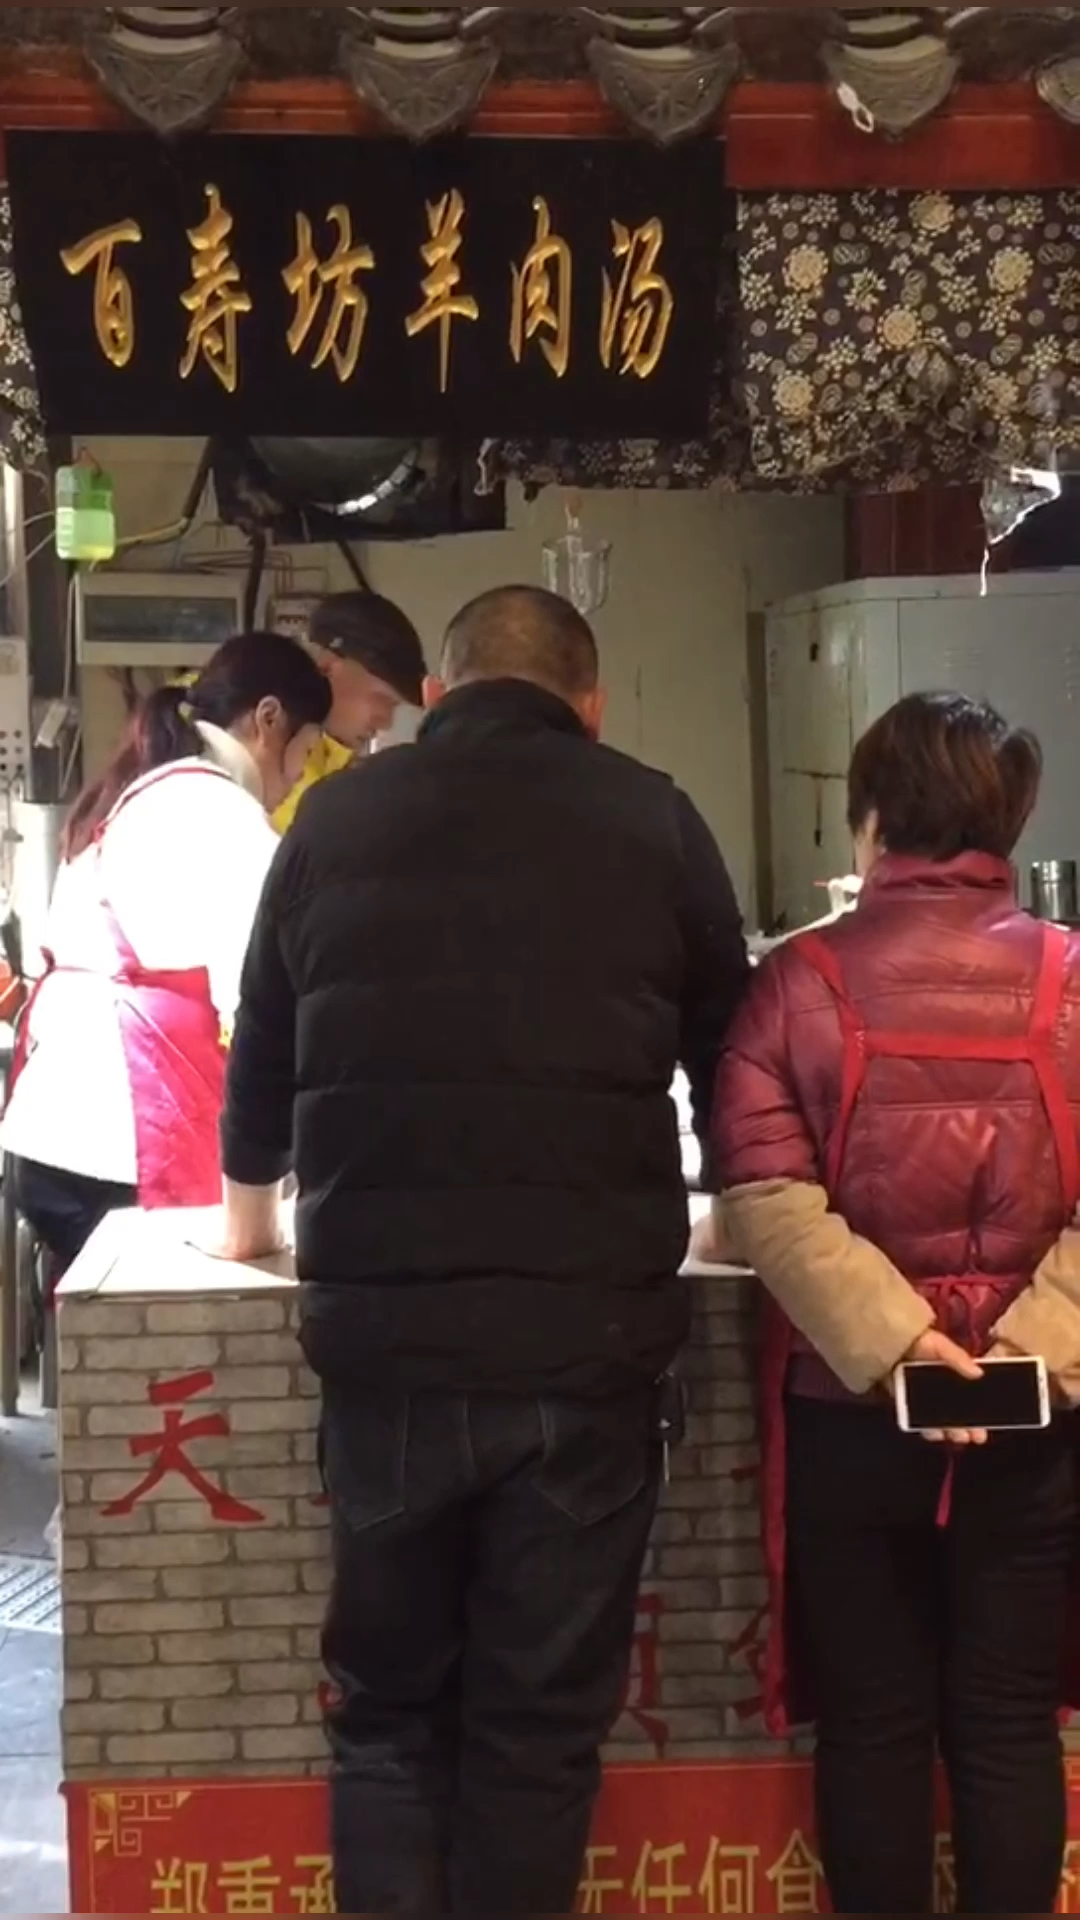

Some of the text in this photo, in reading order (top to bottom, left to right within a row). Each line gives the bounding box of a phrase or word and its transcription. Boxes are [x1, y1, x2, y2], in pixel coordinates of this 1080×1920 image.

[61, 183, 674, 394] 百寿坊羊肉汤
[100, 1370, 266, 1522] 天
